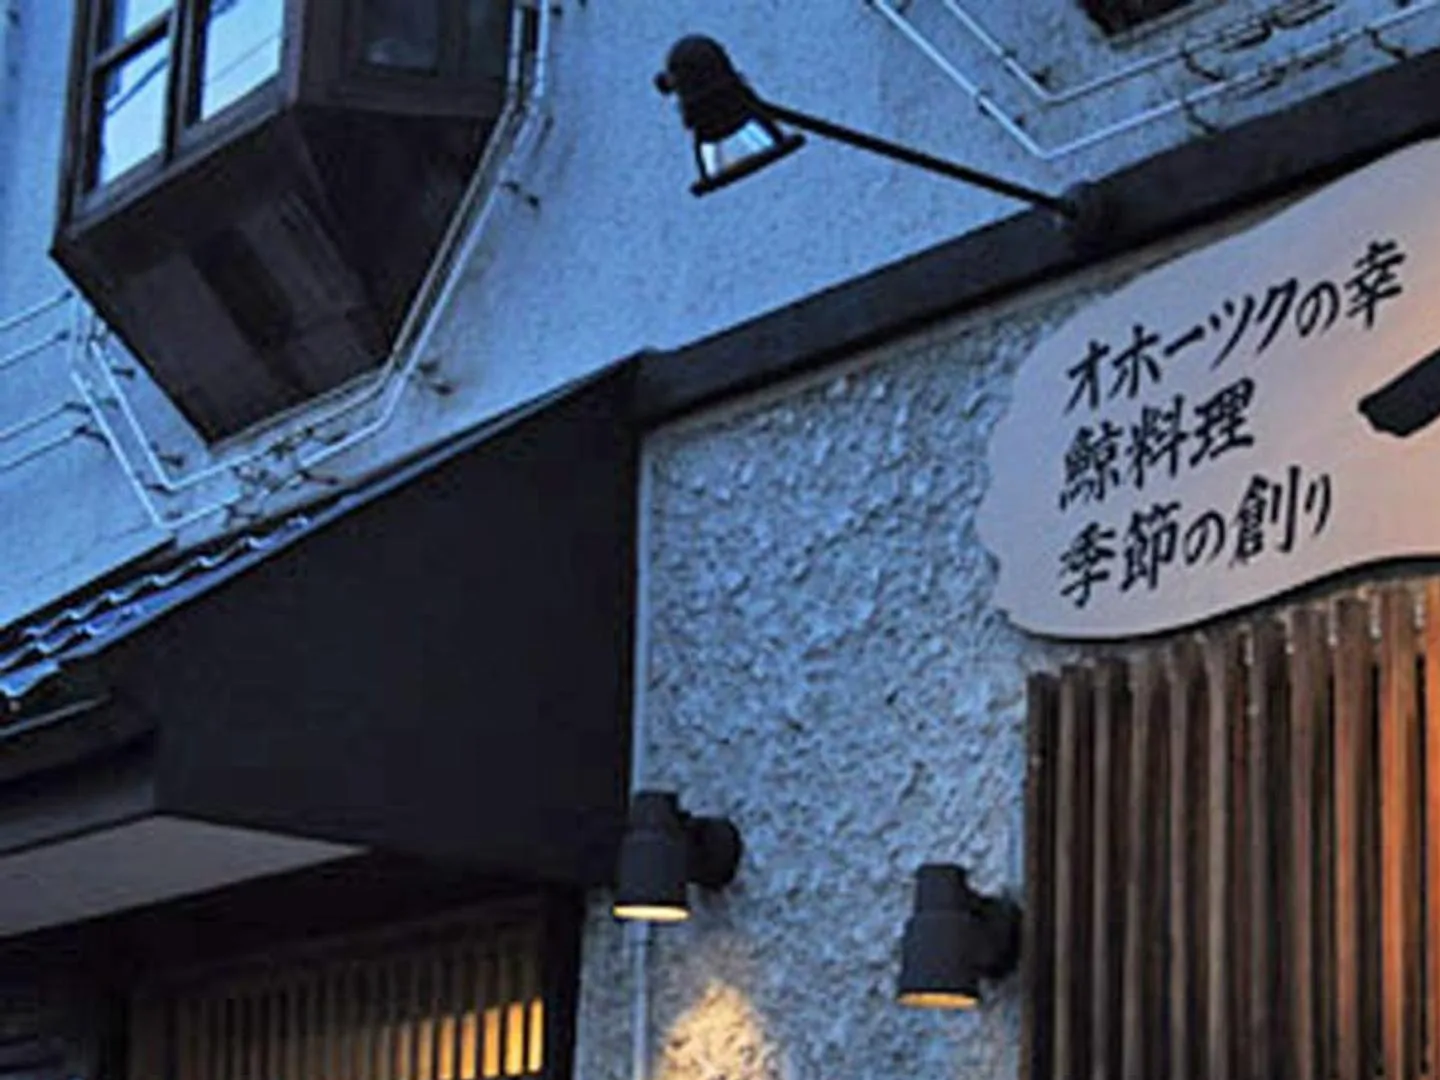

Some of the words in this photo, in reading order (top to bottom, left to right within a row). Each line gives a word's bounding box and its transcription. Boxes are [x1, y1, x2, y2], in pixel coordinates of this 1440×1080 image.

[1064, 240, 1406, 414] オホーツクの幸
[1059, 377, 1256, 510] 鯨料理
[1058, 465, 1332, 608] 季節の創り
